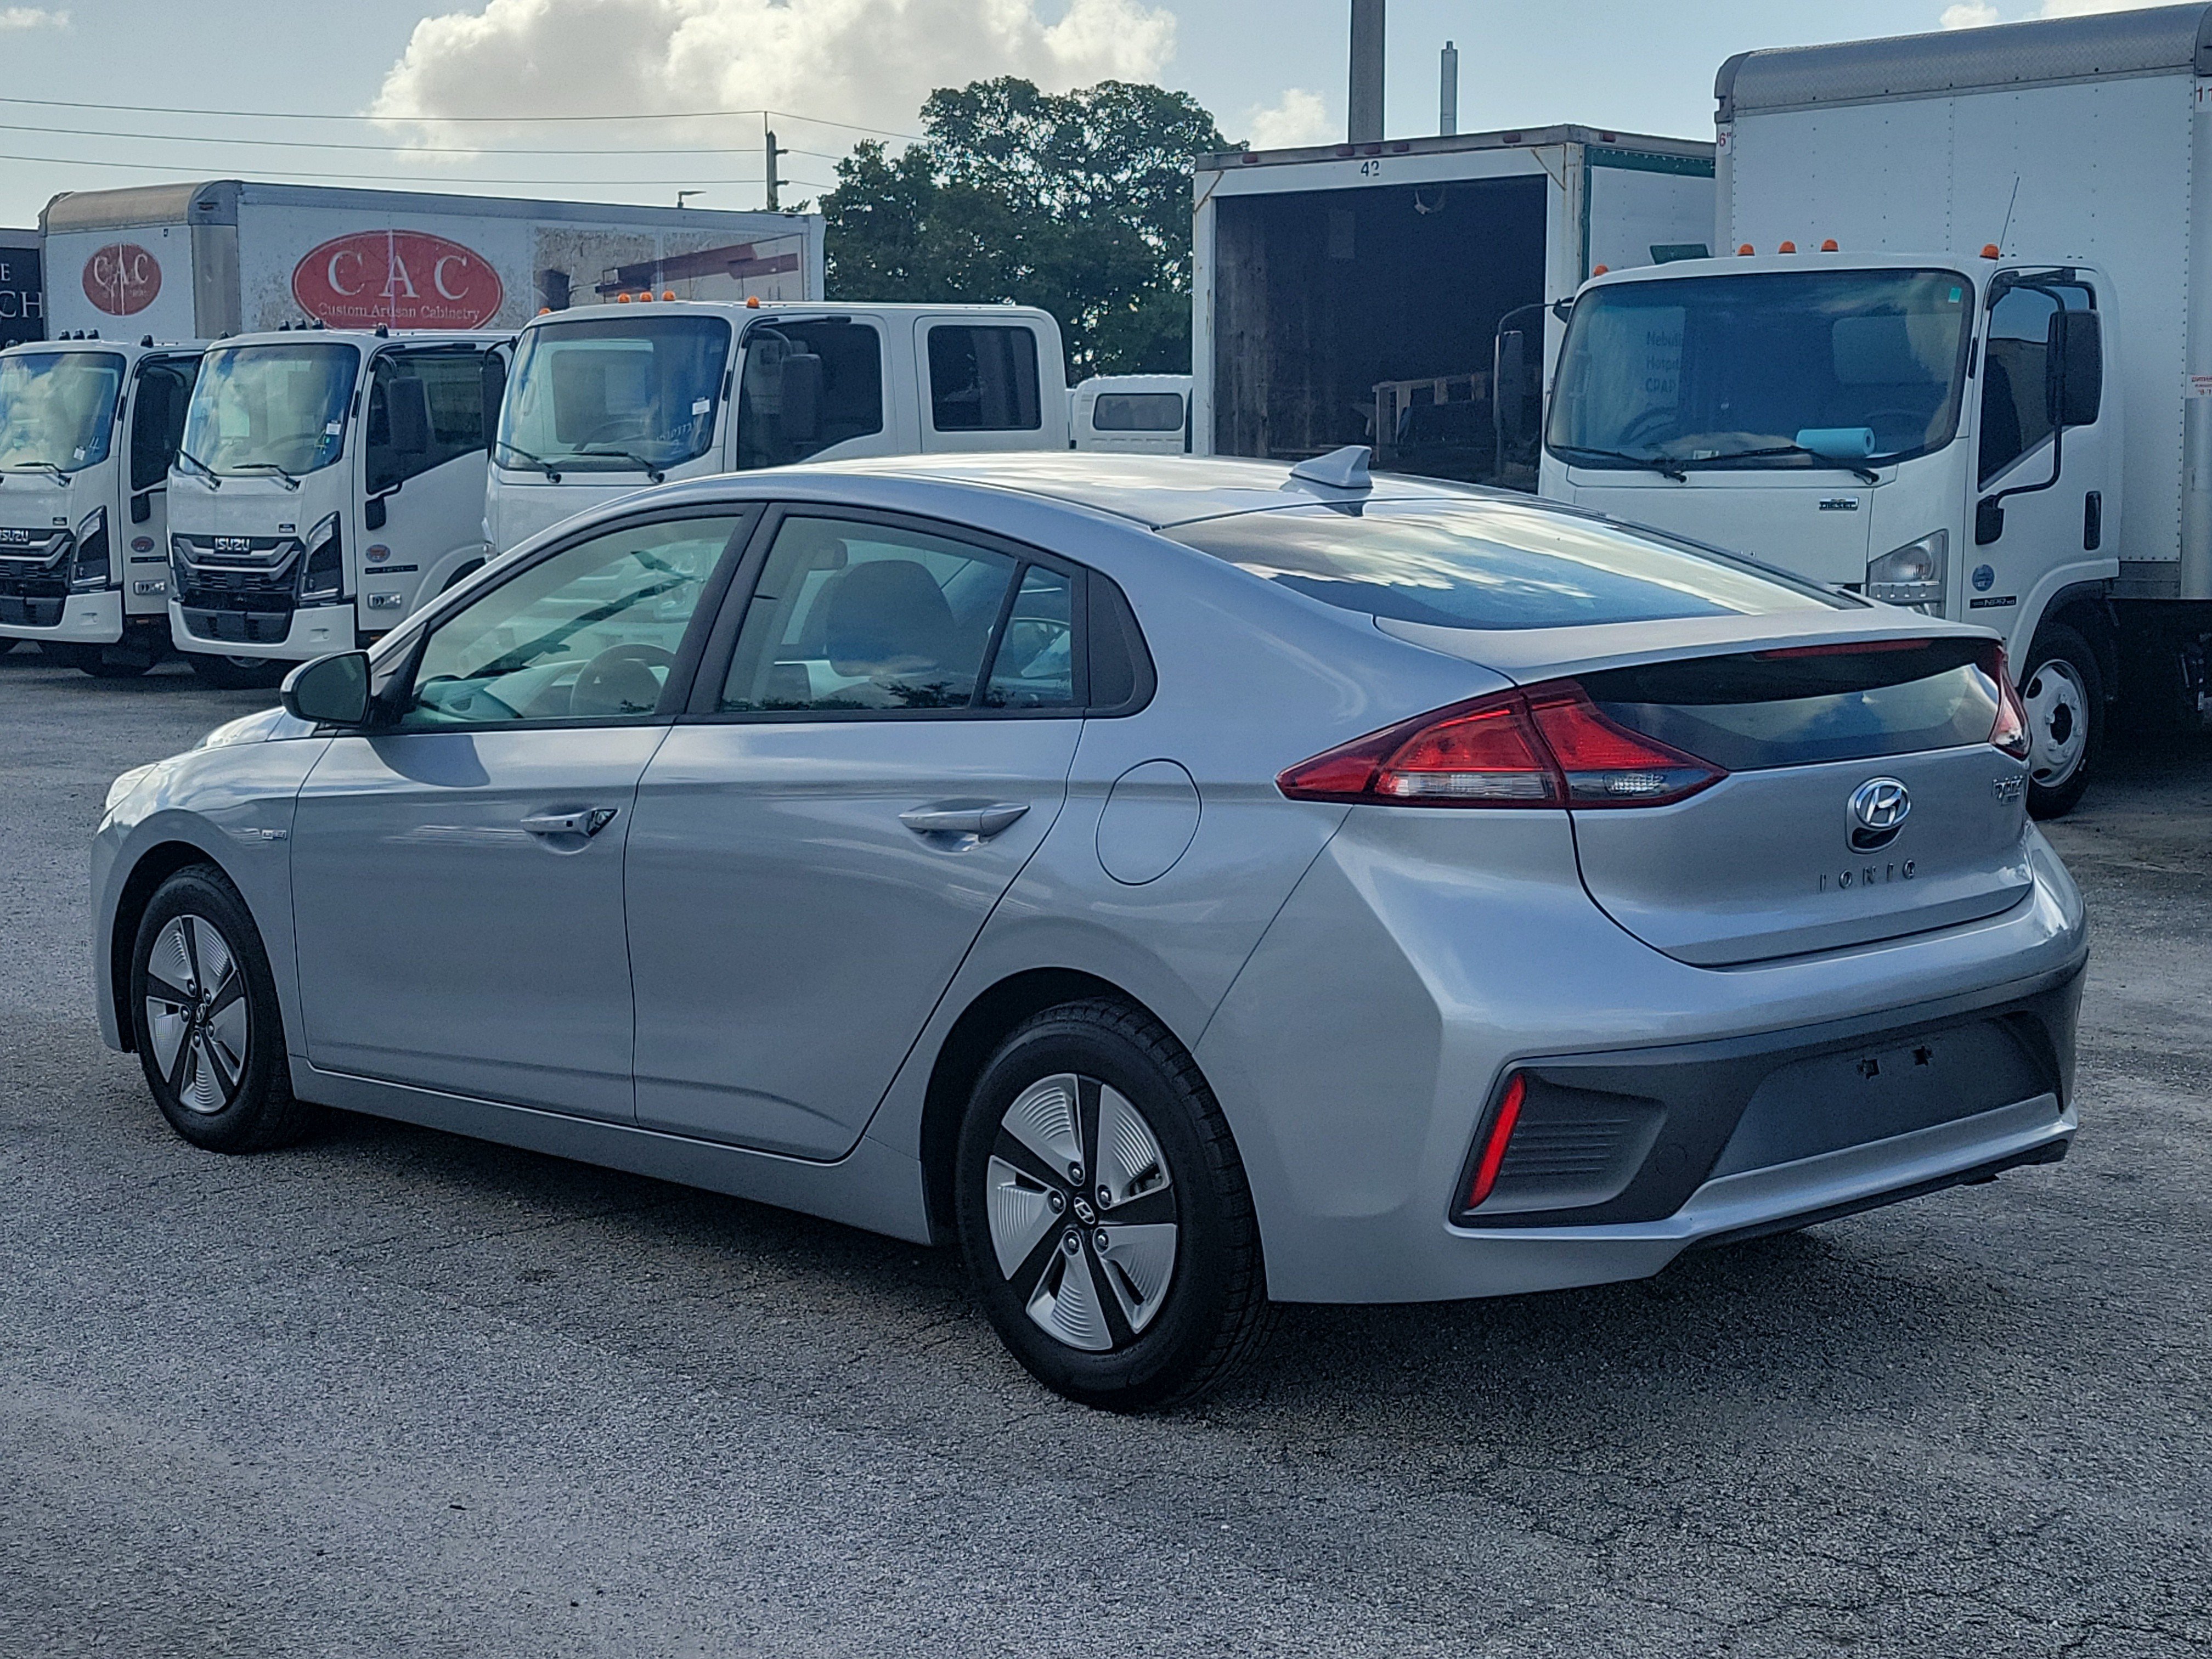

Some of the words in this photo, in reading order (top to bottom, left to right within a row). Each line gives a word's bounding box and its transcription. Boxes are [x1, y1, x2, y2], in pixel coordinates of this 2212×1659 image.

[1361, 160, 1379, 177] 42
[318, 302, 366, 317] Custom
[371, 304, 416, 318] Artisan
[420, 306, 480, 323] Cabinetry
[0, 529, 29, 542] SUZU
[215, 538, 250, 551] ISUZU
